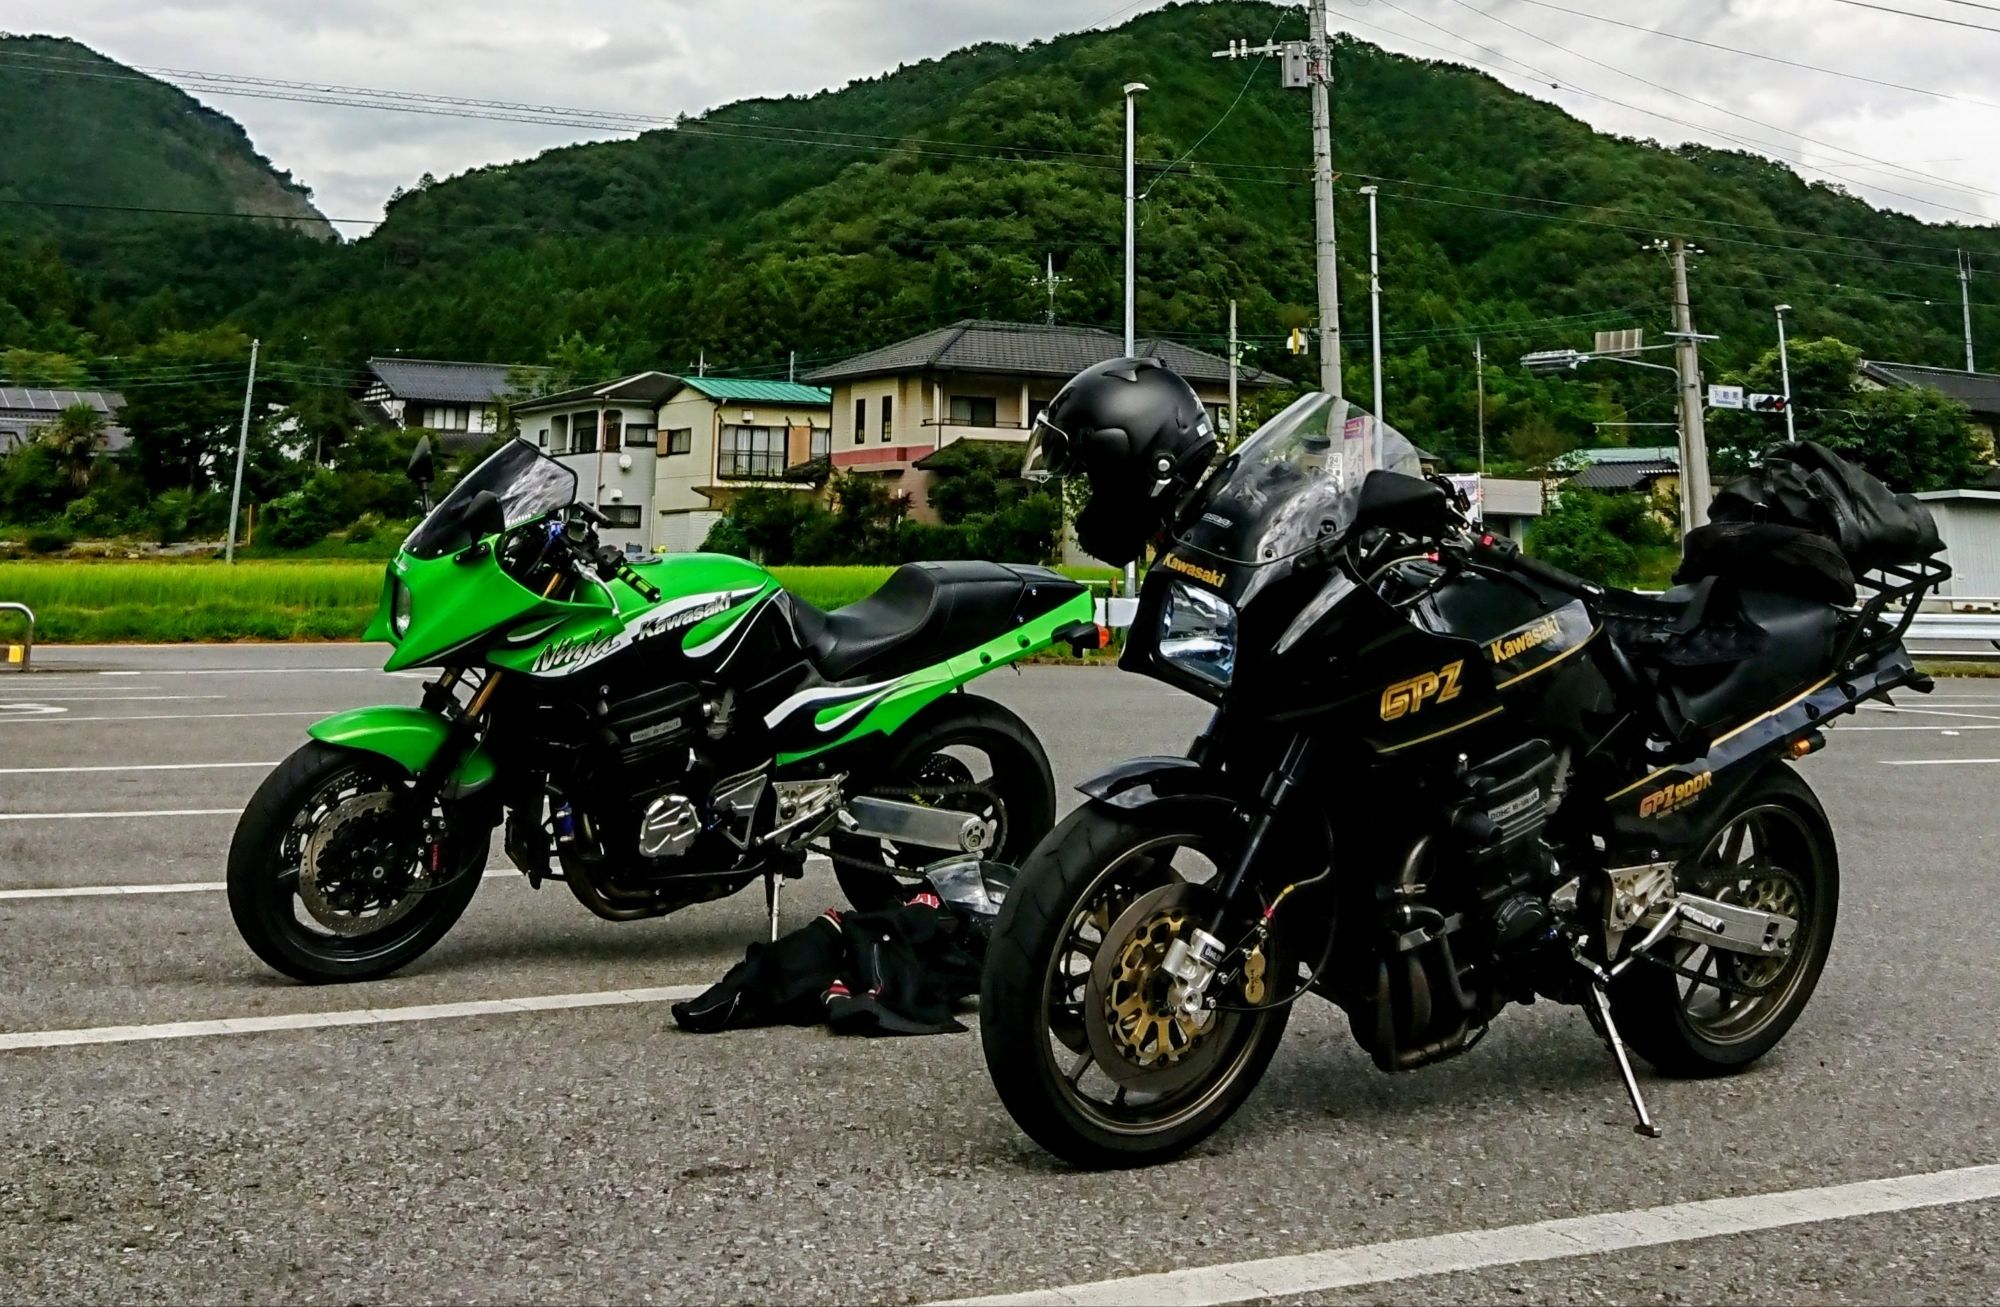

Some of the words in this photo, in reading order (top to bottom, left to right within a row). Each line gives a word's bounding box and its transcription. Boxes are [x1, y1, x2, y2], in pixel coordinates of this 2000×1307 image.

[1162, 552, 1226, 588] Kawasaki
[638, 592, 731, 641] Kawasaki
[1491, 615, 1562, 664] Kawasaki
[531, 627, 621, 674] Ninja
[1380, 659, 1464, 721] GPZ
